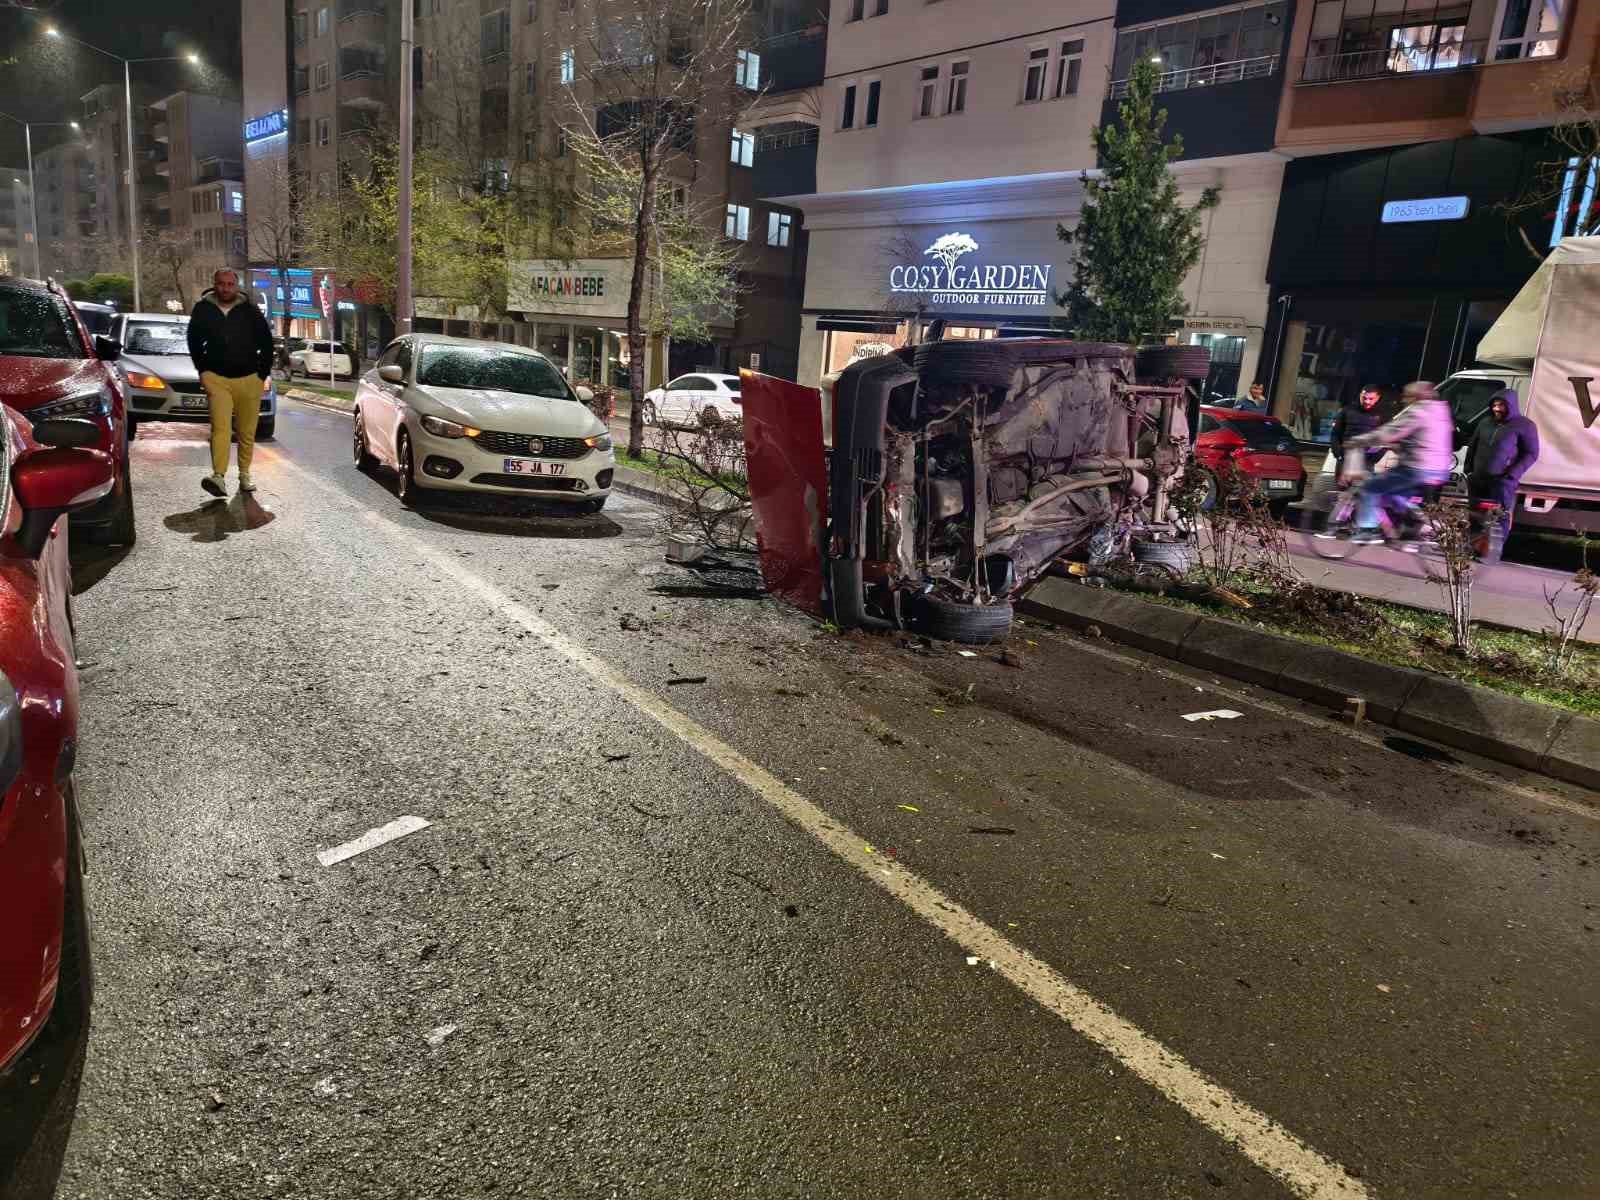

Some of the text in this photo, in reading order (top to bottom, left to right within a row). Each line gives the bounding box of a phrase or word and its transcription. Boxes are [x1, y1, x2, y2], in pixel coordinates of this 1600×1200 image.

[890, 265, 1051, 290] COSY GARDEN
[574, 276, 604, 296] BEBE
[932, 293, 1046, 305] OUTDOOR FURNITURE
[511, 460, 523, 472] 55
[531, 462, 542, 473] JA
